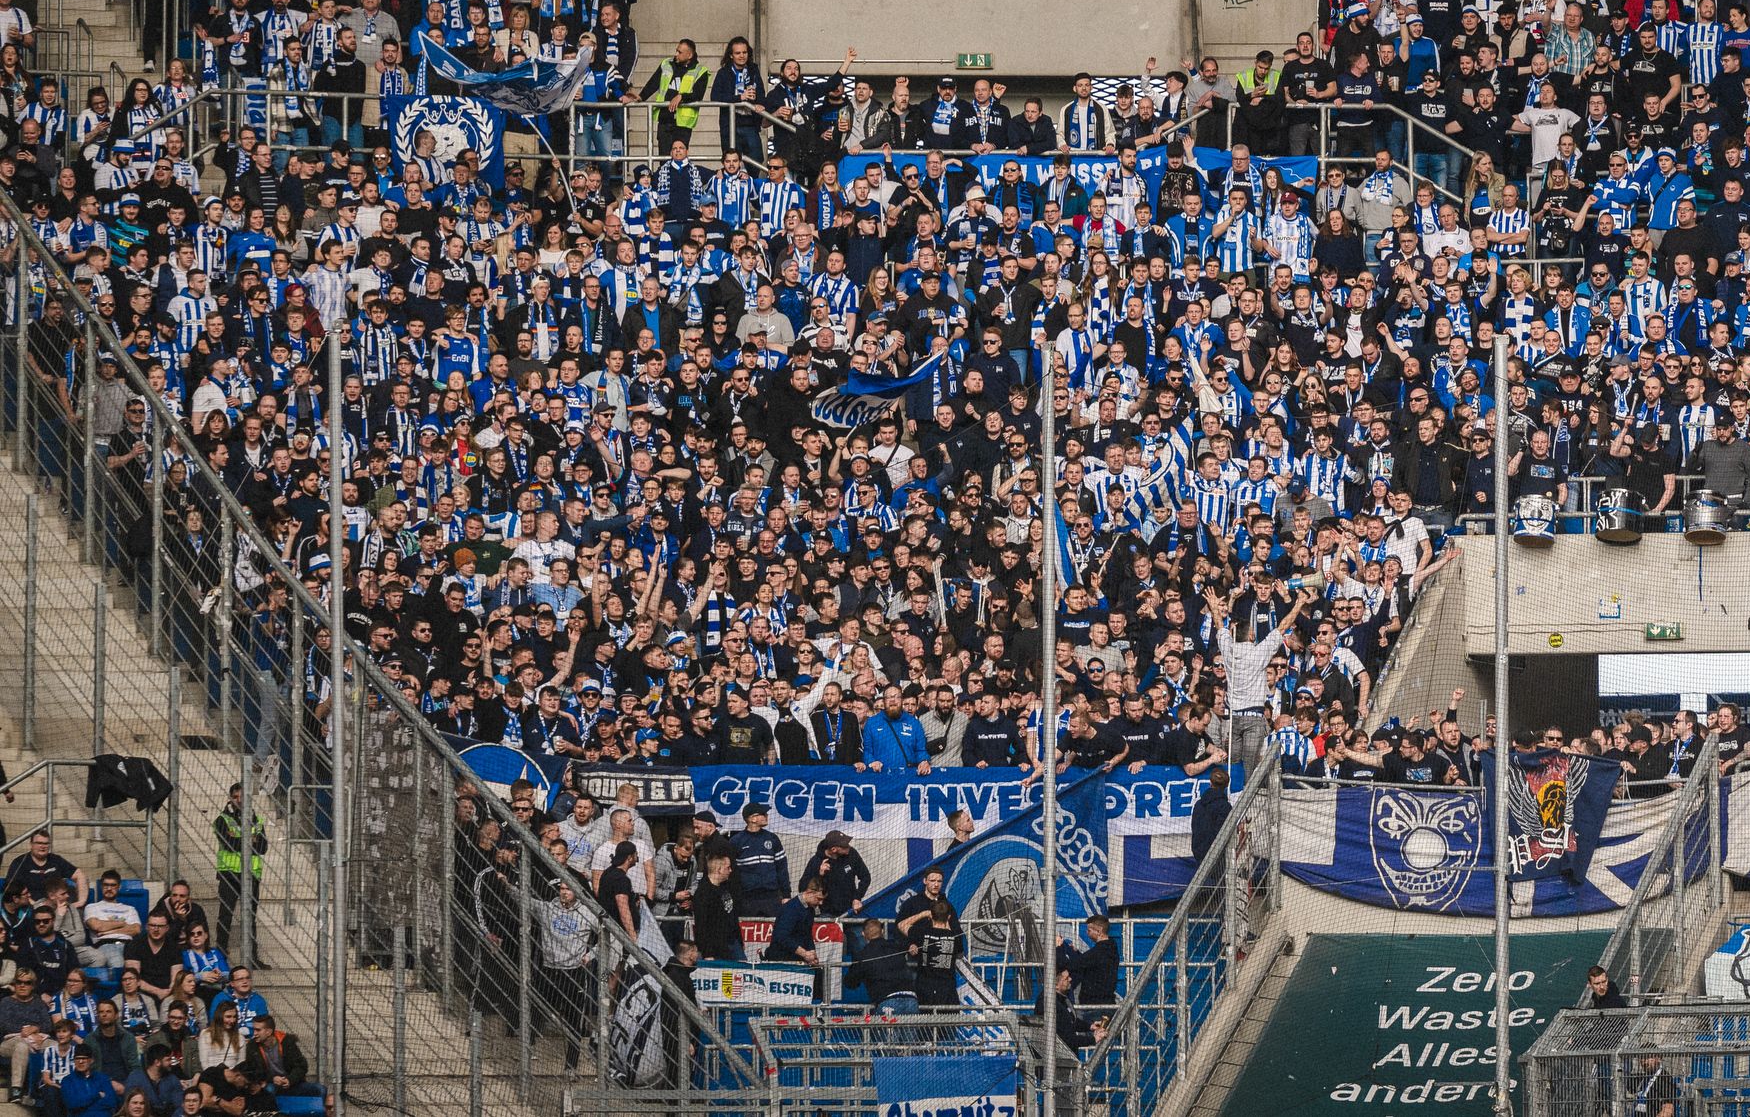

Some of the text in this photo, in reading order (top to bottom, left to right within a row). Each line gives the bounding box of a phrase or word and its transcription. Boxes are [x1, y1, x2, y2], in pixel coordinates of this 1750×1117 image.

[709, 773, 1215, 823] GEGEN INVESORE
[768, 980, 813, 999] ELSTER
[1415, 964, 1536, 994] Zero
[1378, 1003, 1546, 1032] Waste.
[1374, 1041, 1513, 1069] Alles
